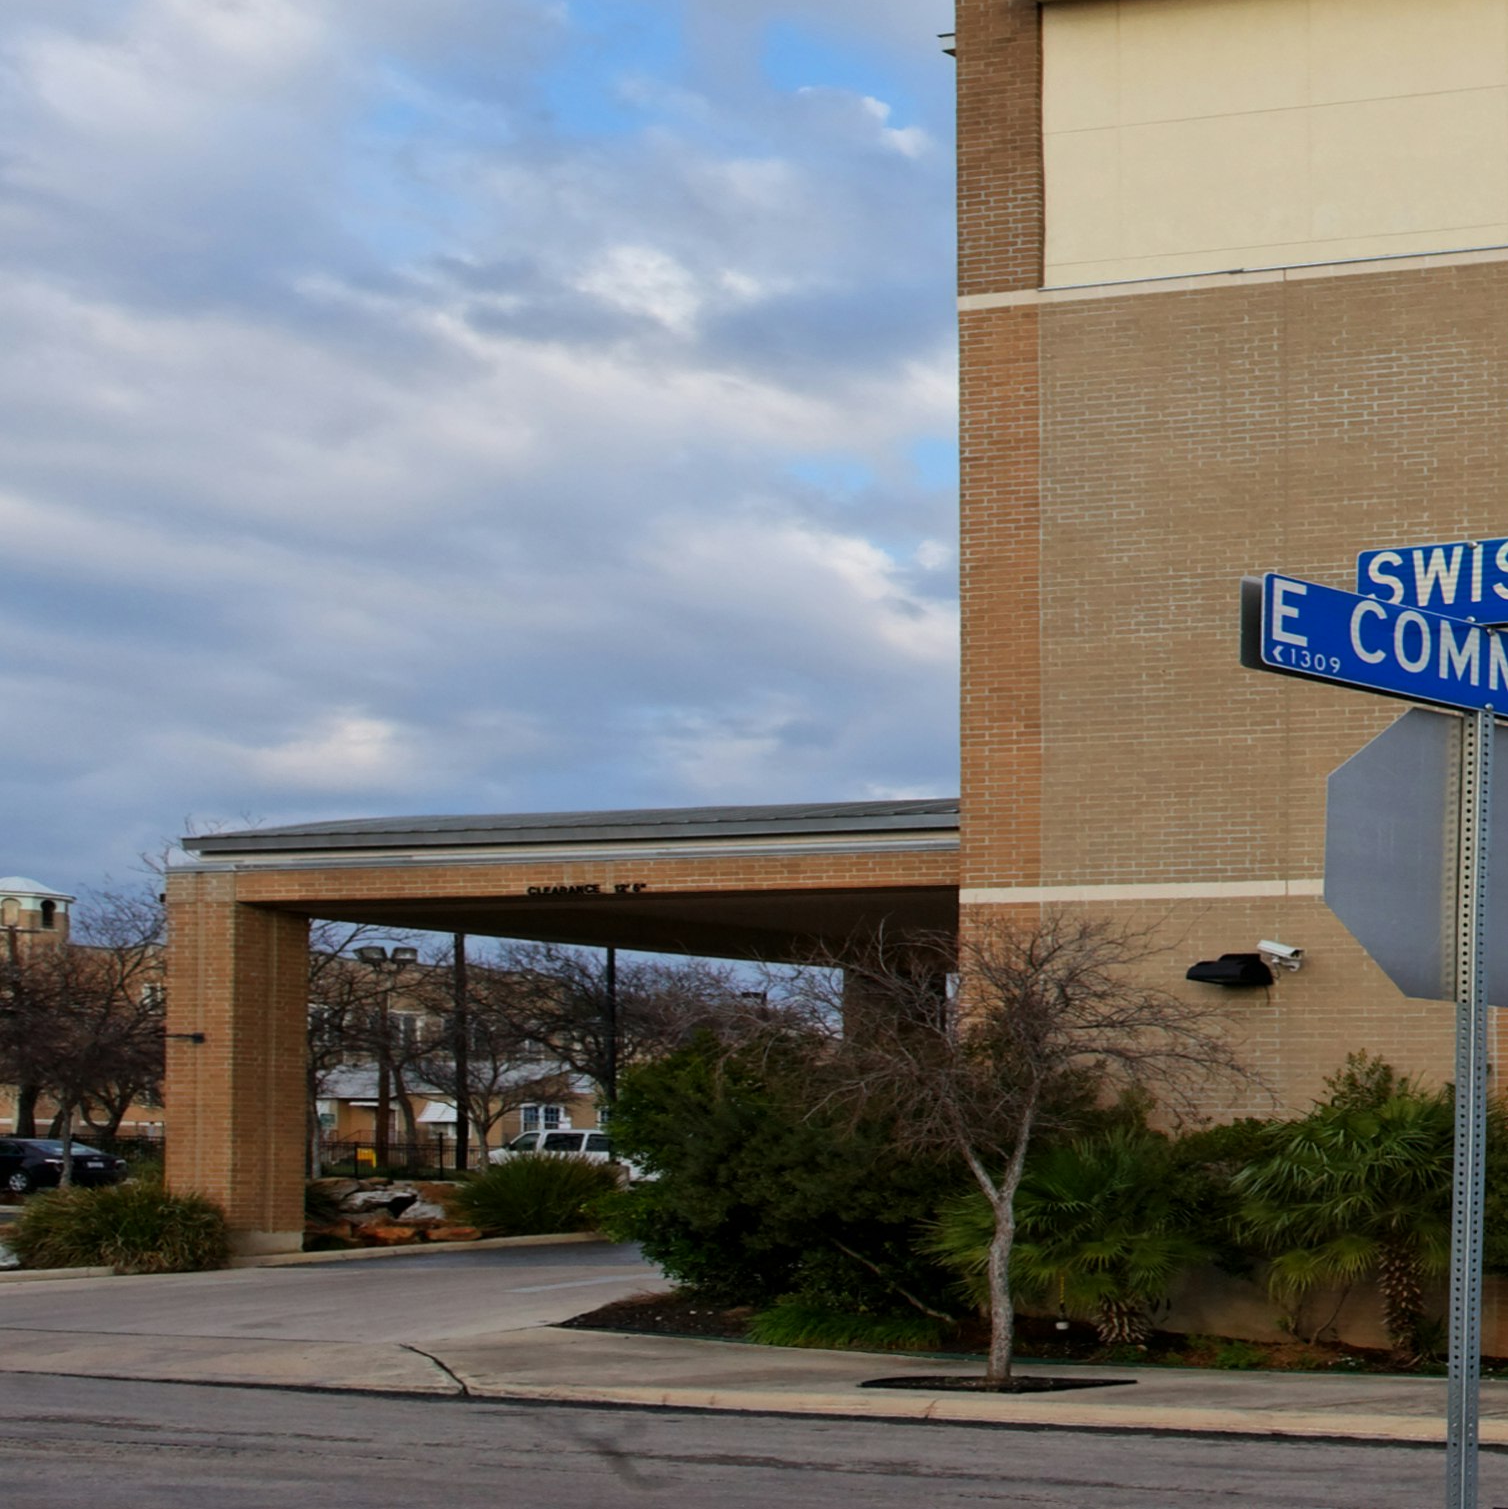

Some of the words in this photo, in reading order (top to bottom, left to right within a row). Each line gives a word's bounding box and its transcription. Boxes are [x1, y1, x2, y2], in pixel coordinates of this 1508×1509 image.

[1271, 578, 1308, 648] E
[1290, 648, 1341, 674] 1309
[527, 885, 600, 895] CLEARANCE
